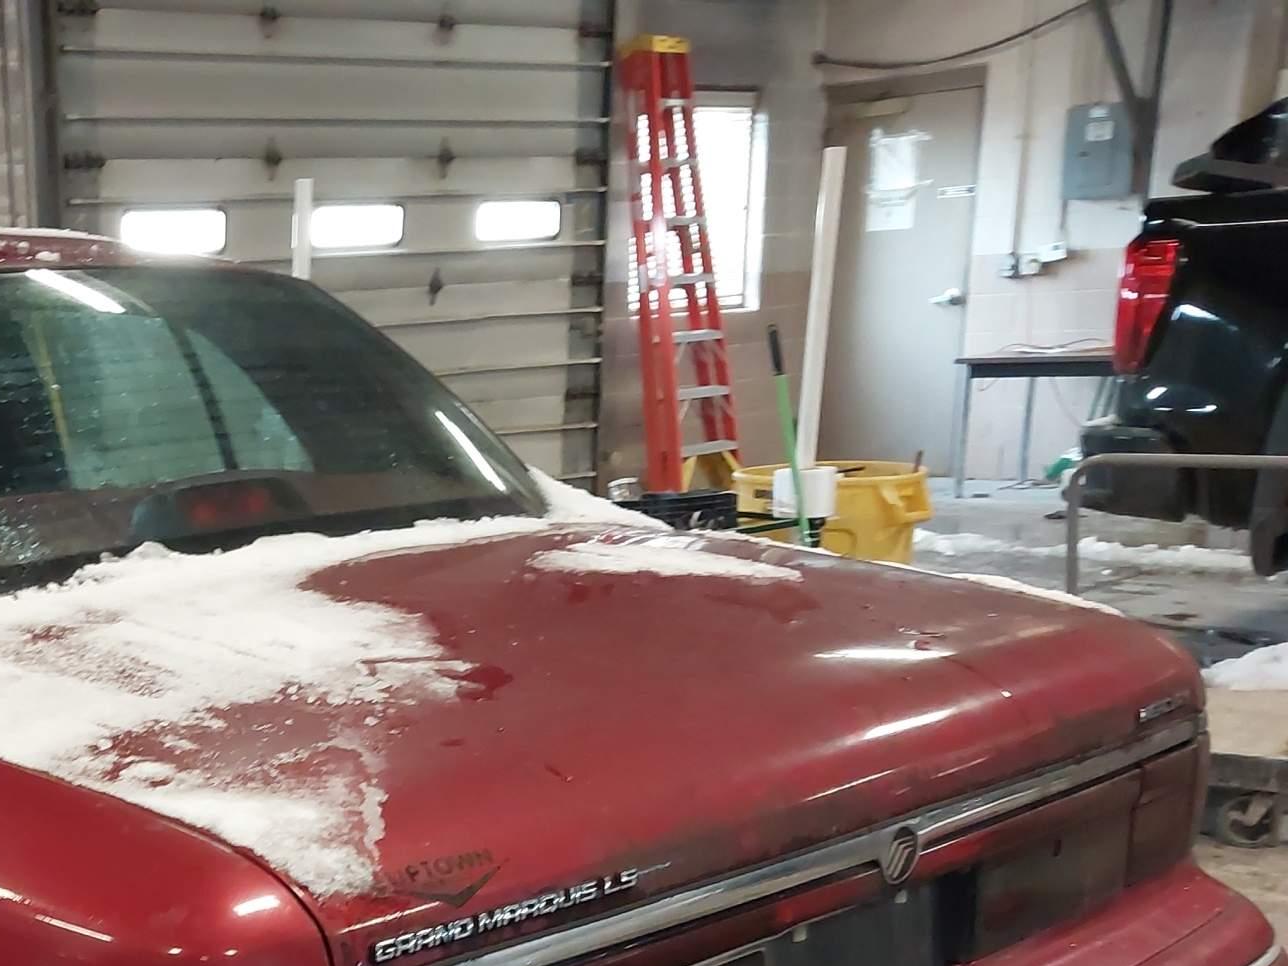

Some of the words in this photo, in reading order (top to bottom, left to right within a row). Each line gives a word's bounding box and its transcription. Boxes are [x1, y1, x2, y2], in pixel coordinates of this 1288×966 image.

[374, 916, 475, 962] GRAND
[477, 880, 598, 933] MARQUIS
[603, 868, 639, 895] LS
